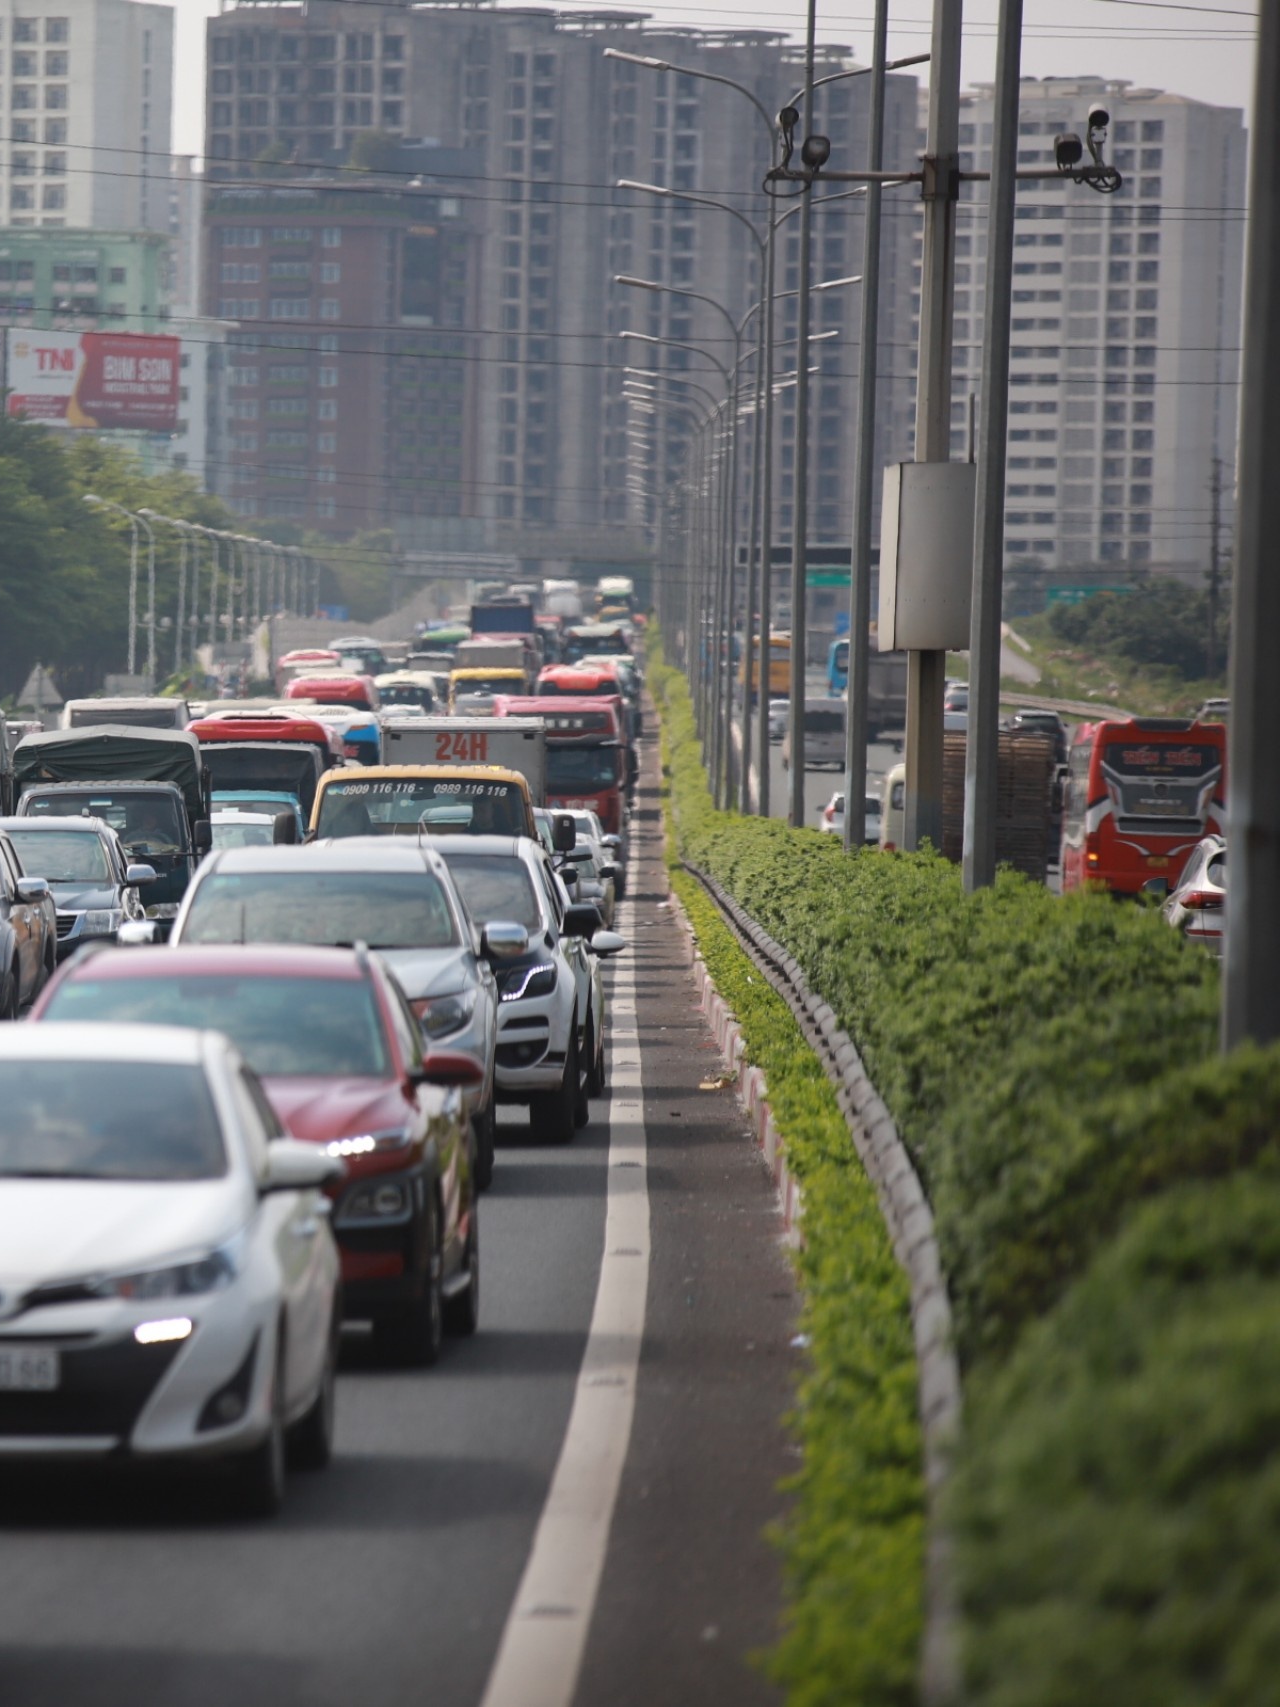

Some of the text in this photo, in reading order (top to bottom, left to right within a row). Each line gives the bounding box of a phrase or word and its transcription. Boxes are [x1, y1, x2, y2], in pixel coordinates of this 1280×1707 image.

[435, 732, 487, 761] 24H
[342, 783, 370, 796] 0909
[372, 782, 393, 794] 116
[396, 782, 416, 793] 116
[433, 783, 461, 794] 0989
[464, 784, 484, 795] 116
[487, 785, 507, 797] 116
